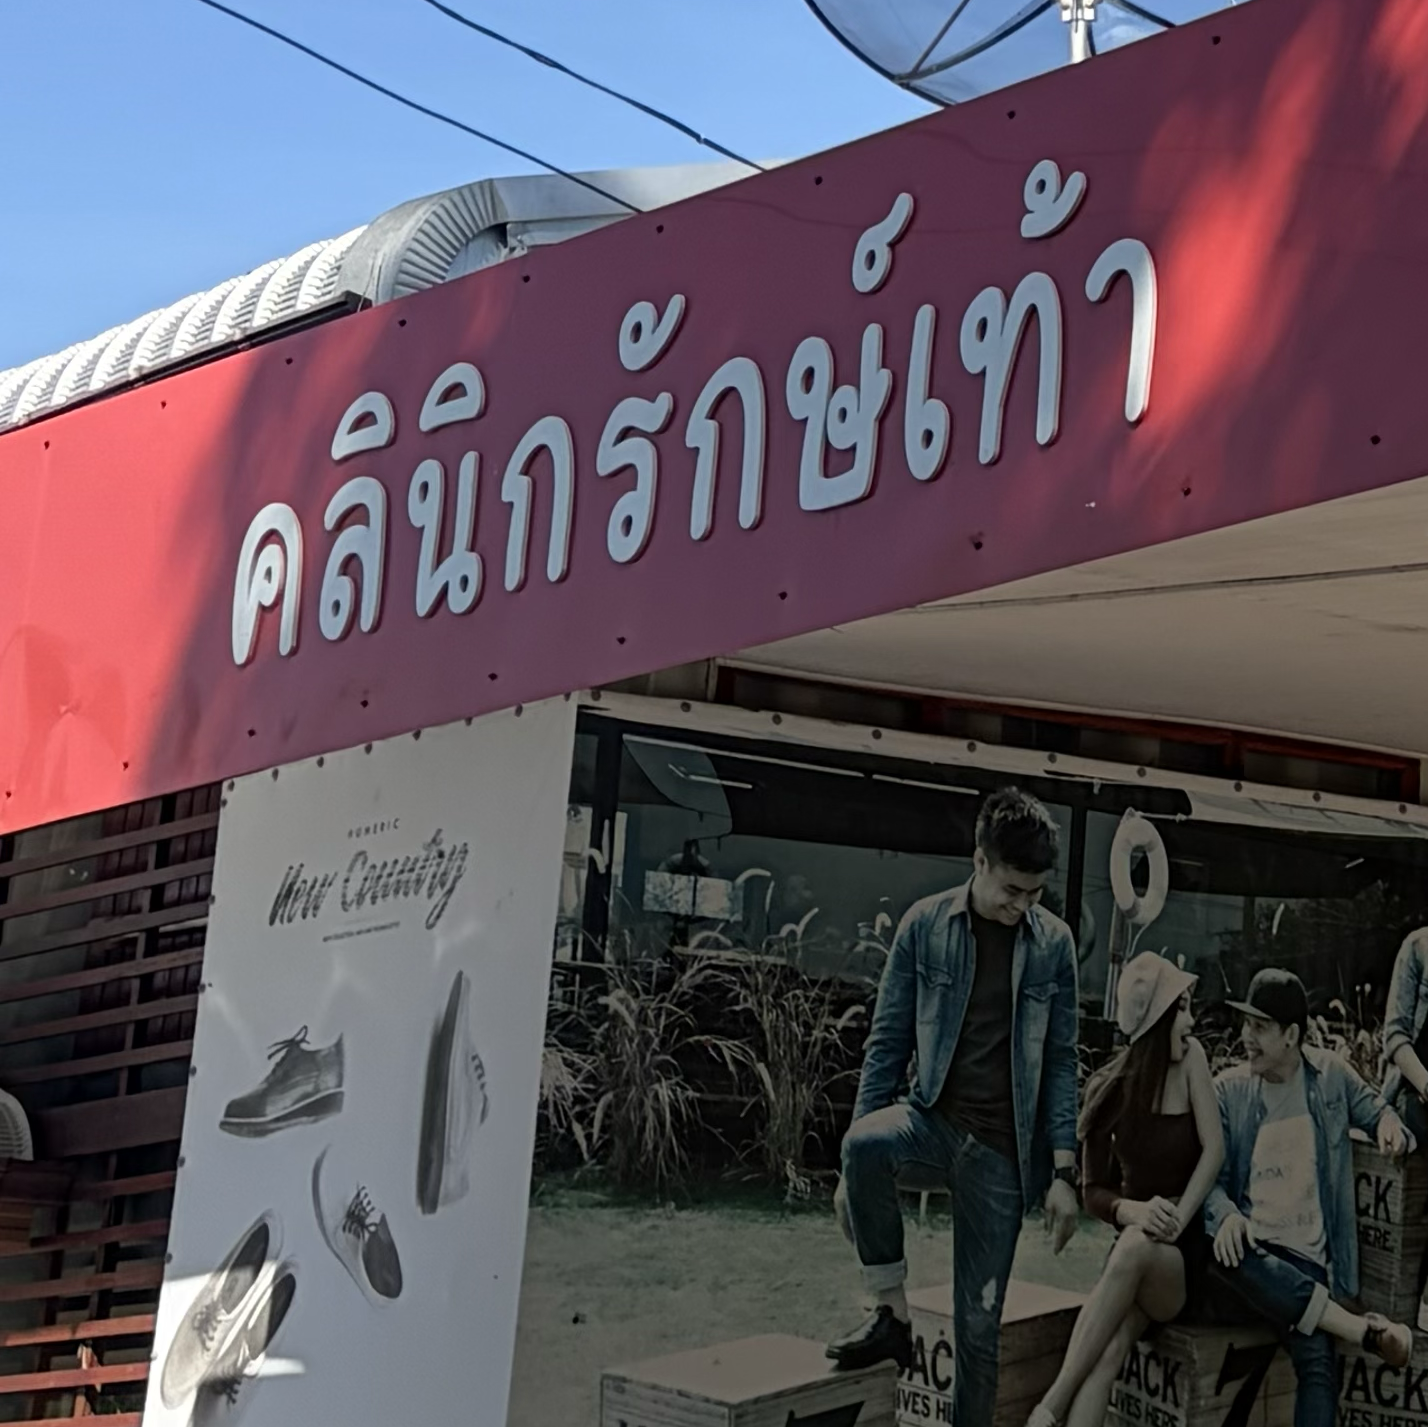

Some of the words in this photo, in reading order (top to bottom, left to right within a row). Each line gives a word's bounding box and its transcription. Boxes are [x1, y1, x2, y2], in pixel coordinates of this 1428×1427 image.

[231, 158, 1159, 666] คลินิกรักษ์เท้า
[1355, 1172, 1394, 1225] CK
[896, 1388, 931, 1419] IVES
